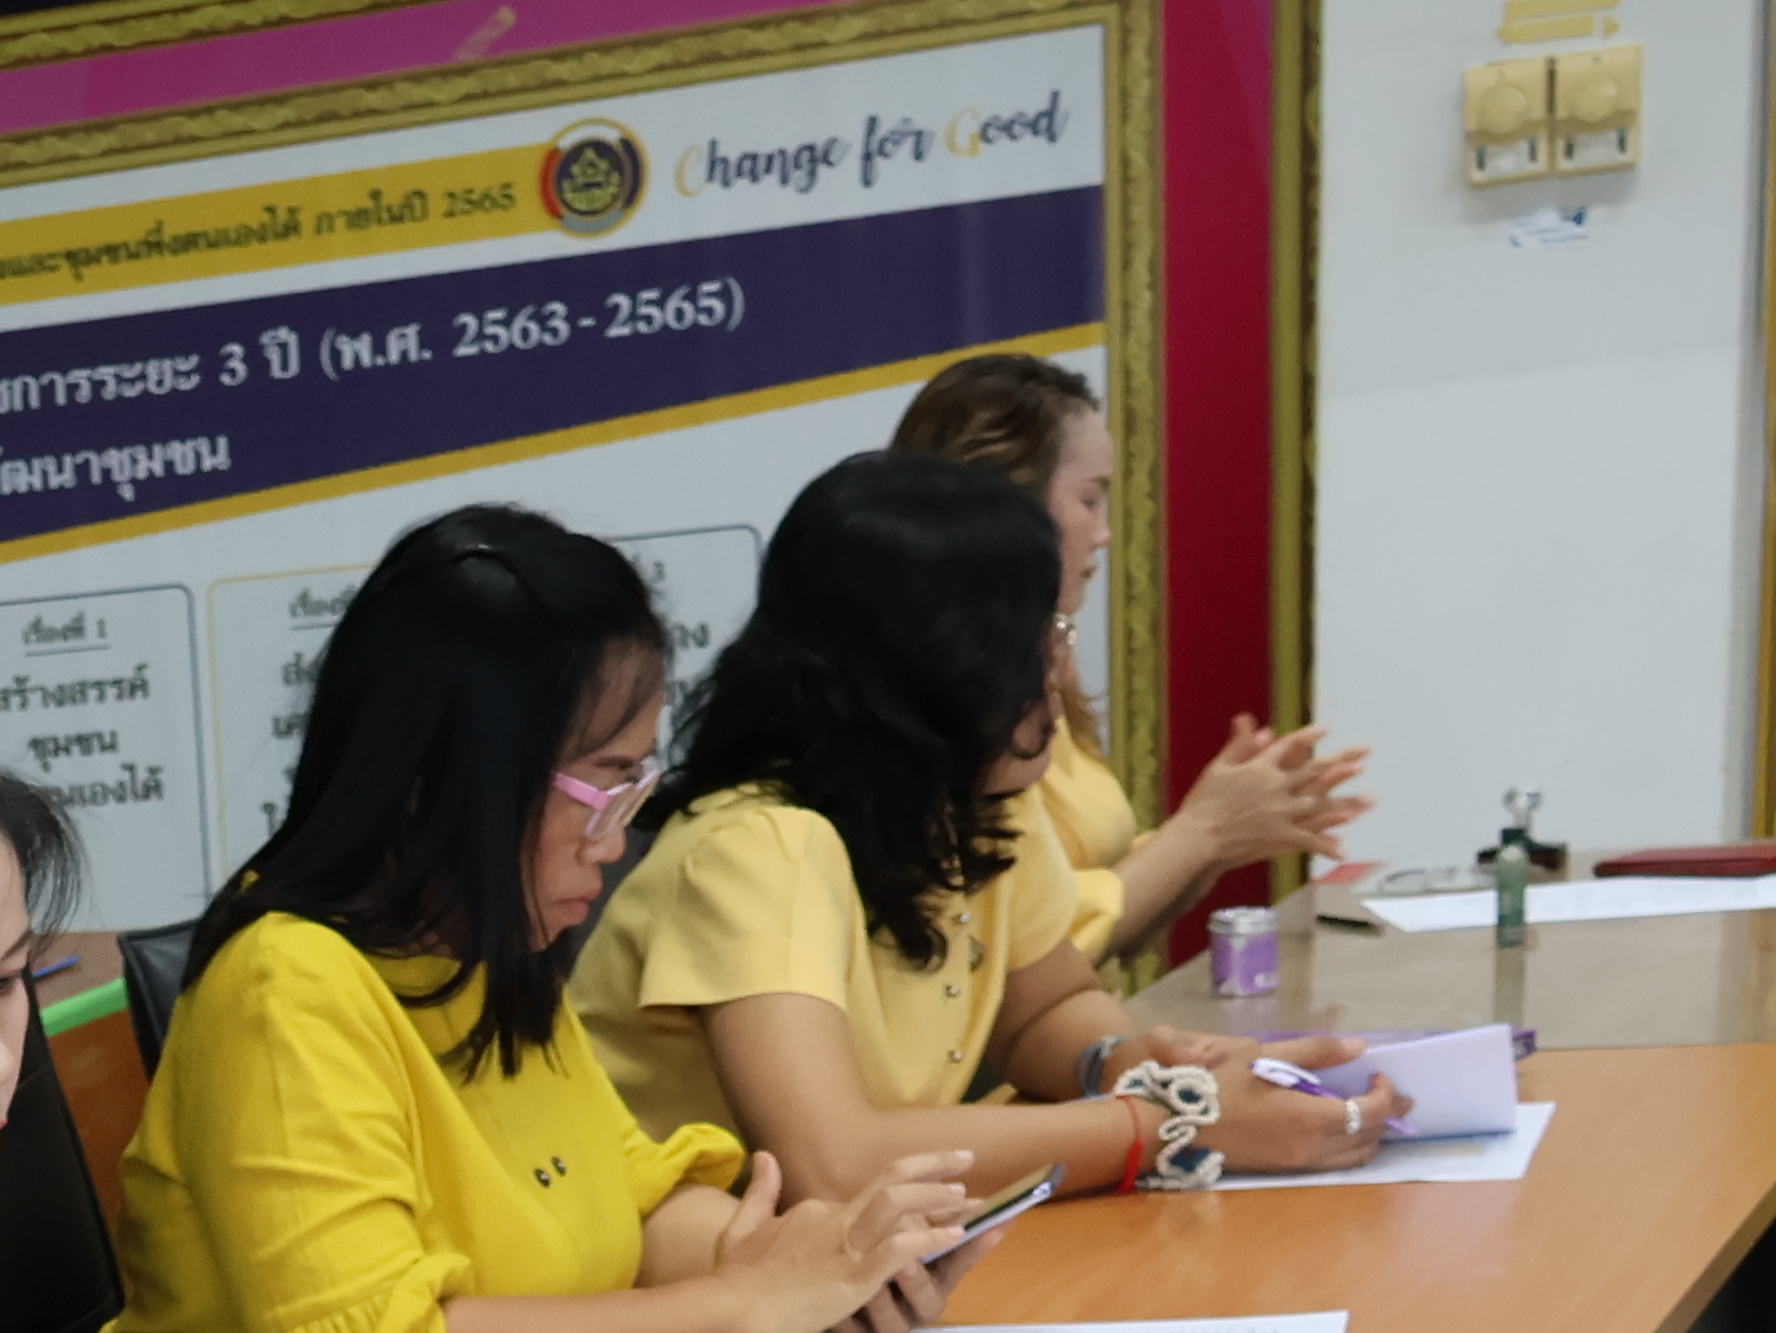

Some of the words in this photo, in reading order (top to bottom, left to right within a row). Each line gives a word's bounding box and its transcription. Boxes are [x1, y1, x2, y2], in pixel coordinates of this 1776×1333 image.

[674, 134, 848, 197] Change
[860, 116, 933, 189] for
[945, 90, 1069, 159] Good
[442, 181, 516, 220] 2565
[219, 345, 247, 386] 3
[262, 326, 302, 381] ปี
[321, 320, 433, 381] (พ.ศ.
[28, 730, 119, 773] ชุมชน
